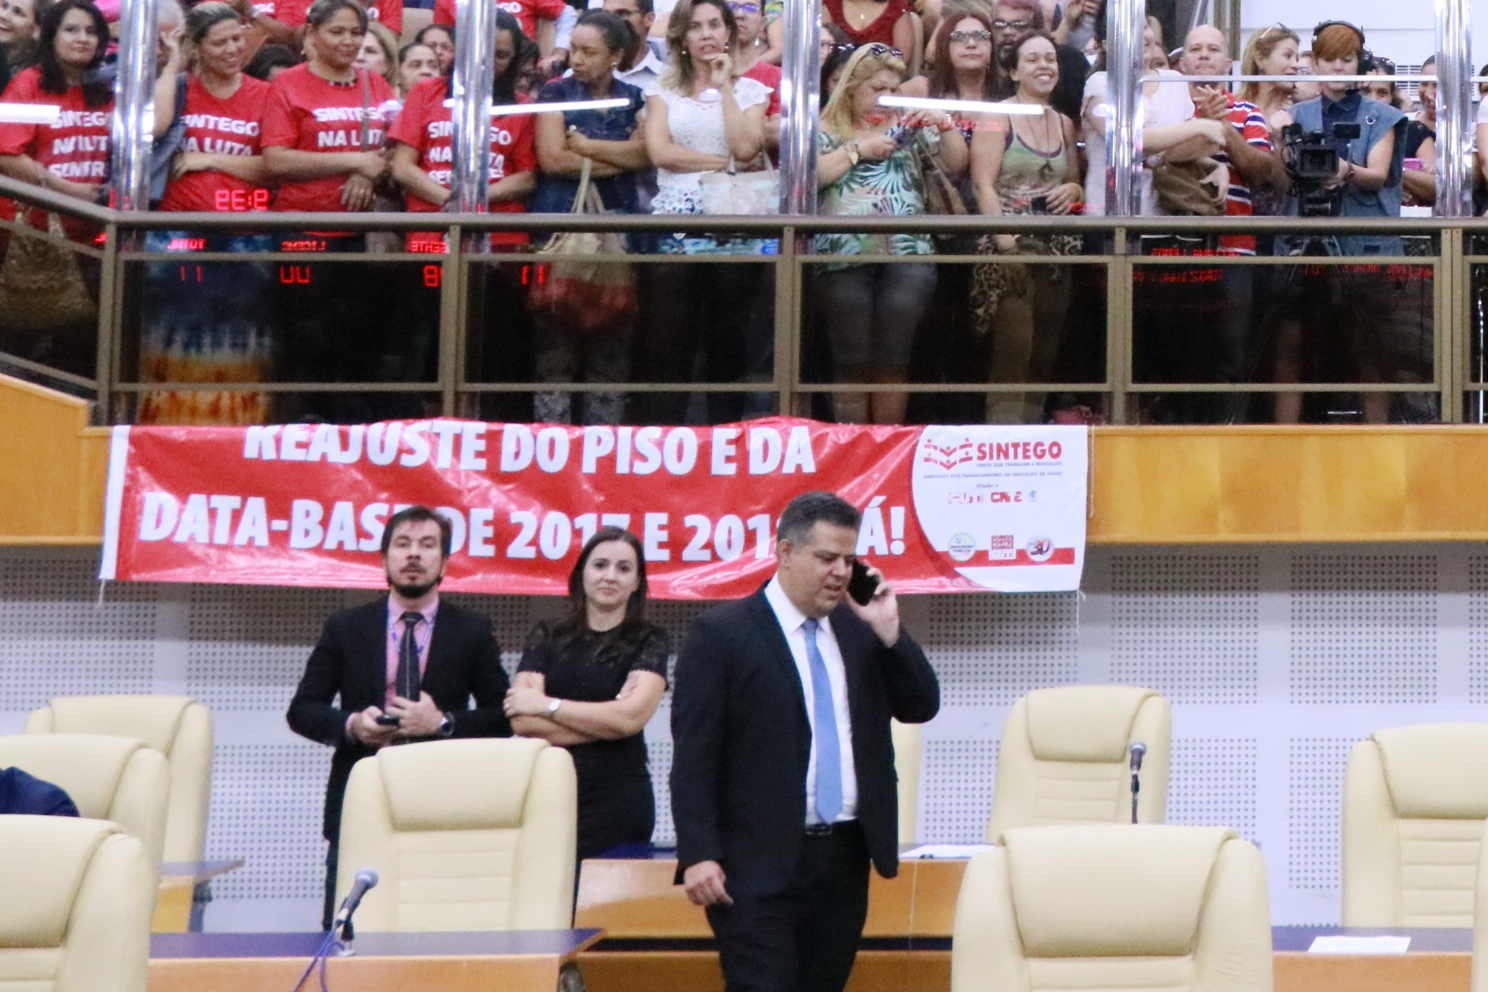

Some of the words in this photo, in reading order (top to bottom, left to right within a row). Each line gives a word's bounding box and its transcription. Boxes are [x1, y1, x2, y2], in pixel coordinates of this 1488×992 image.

[317, 129, 348, 147] NA
[500, 423, 569, 475] DO
[582, 425, 698, 476] PISO
[710, 426, 737, 476] E
[748, 425, 817, 475] DA
[976, 440, 1063, 461] SINTEGO
[138, 491, 415, 553] DATA-BAS
[644, 512, 671, 562] E
[681, 513, 780, 562] 201
[855, 494, 906, 556] Á!
